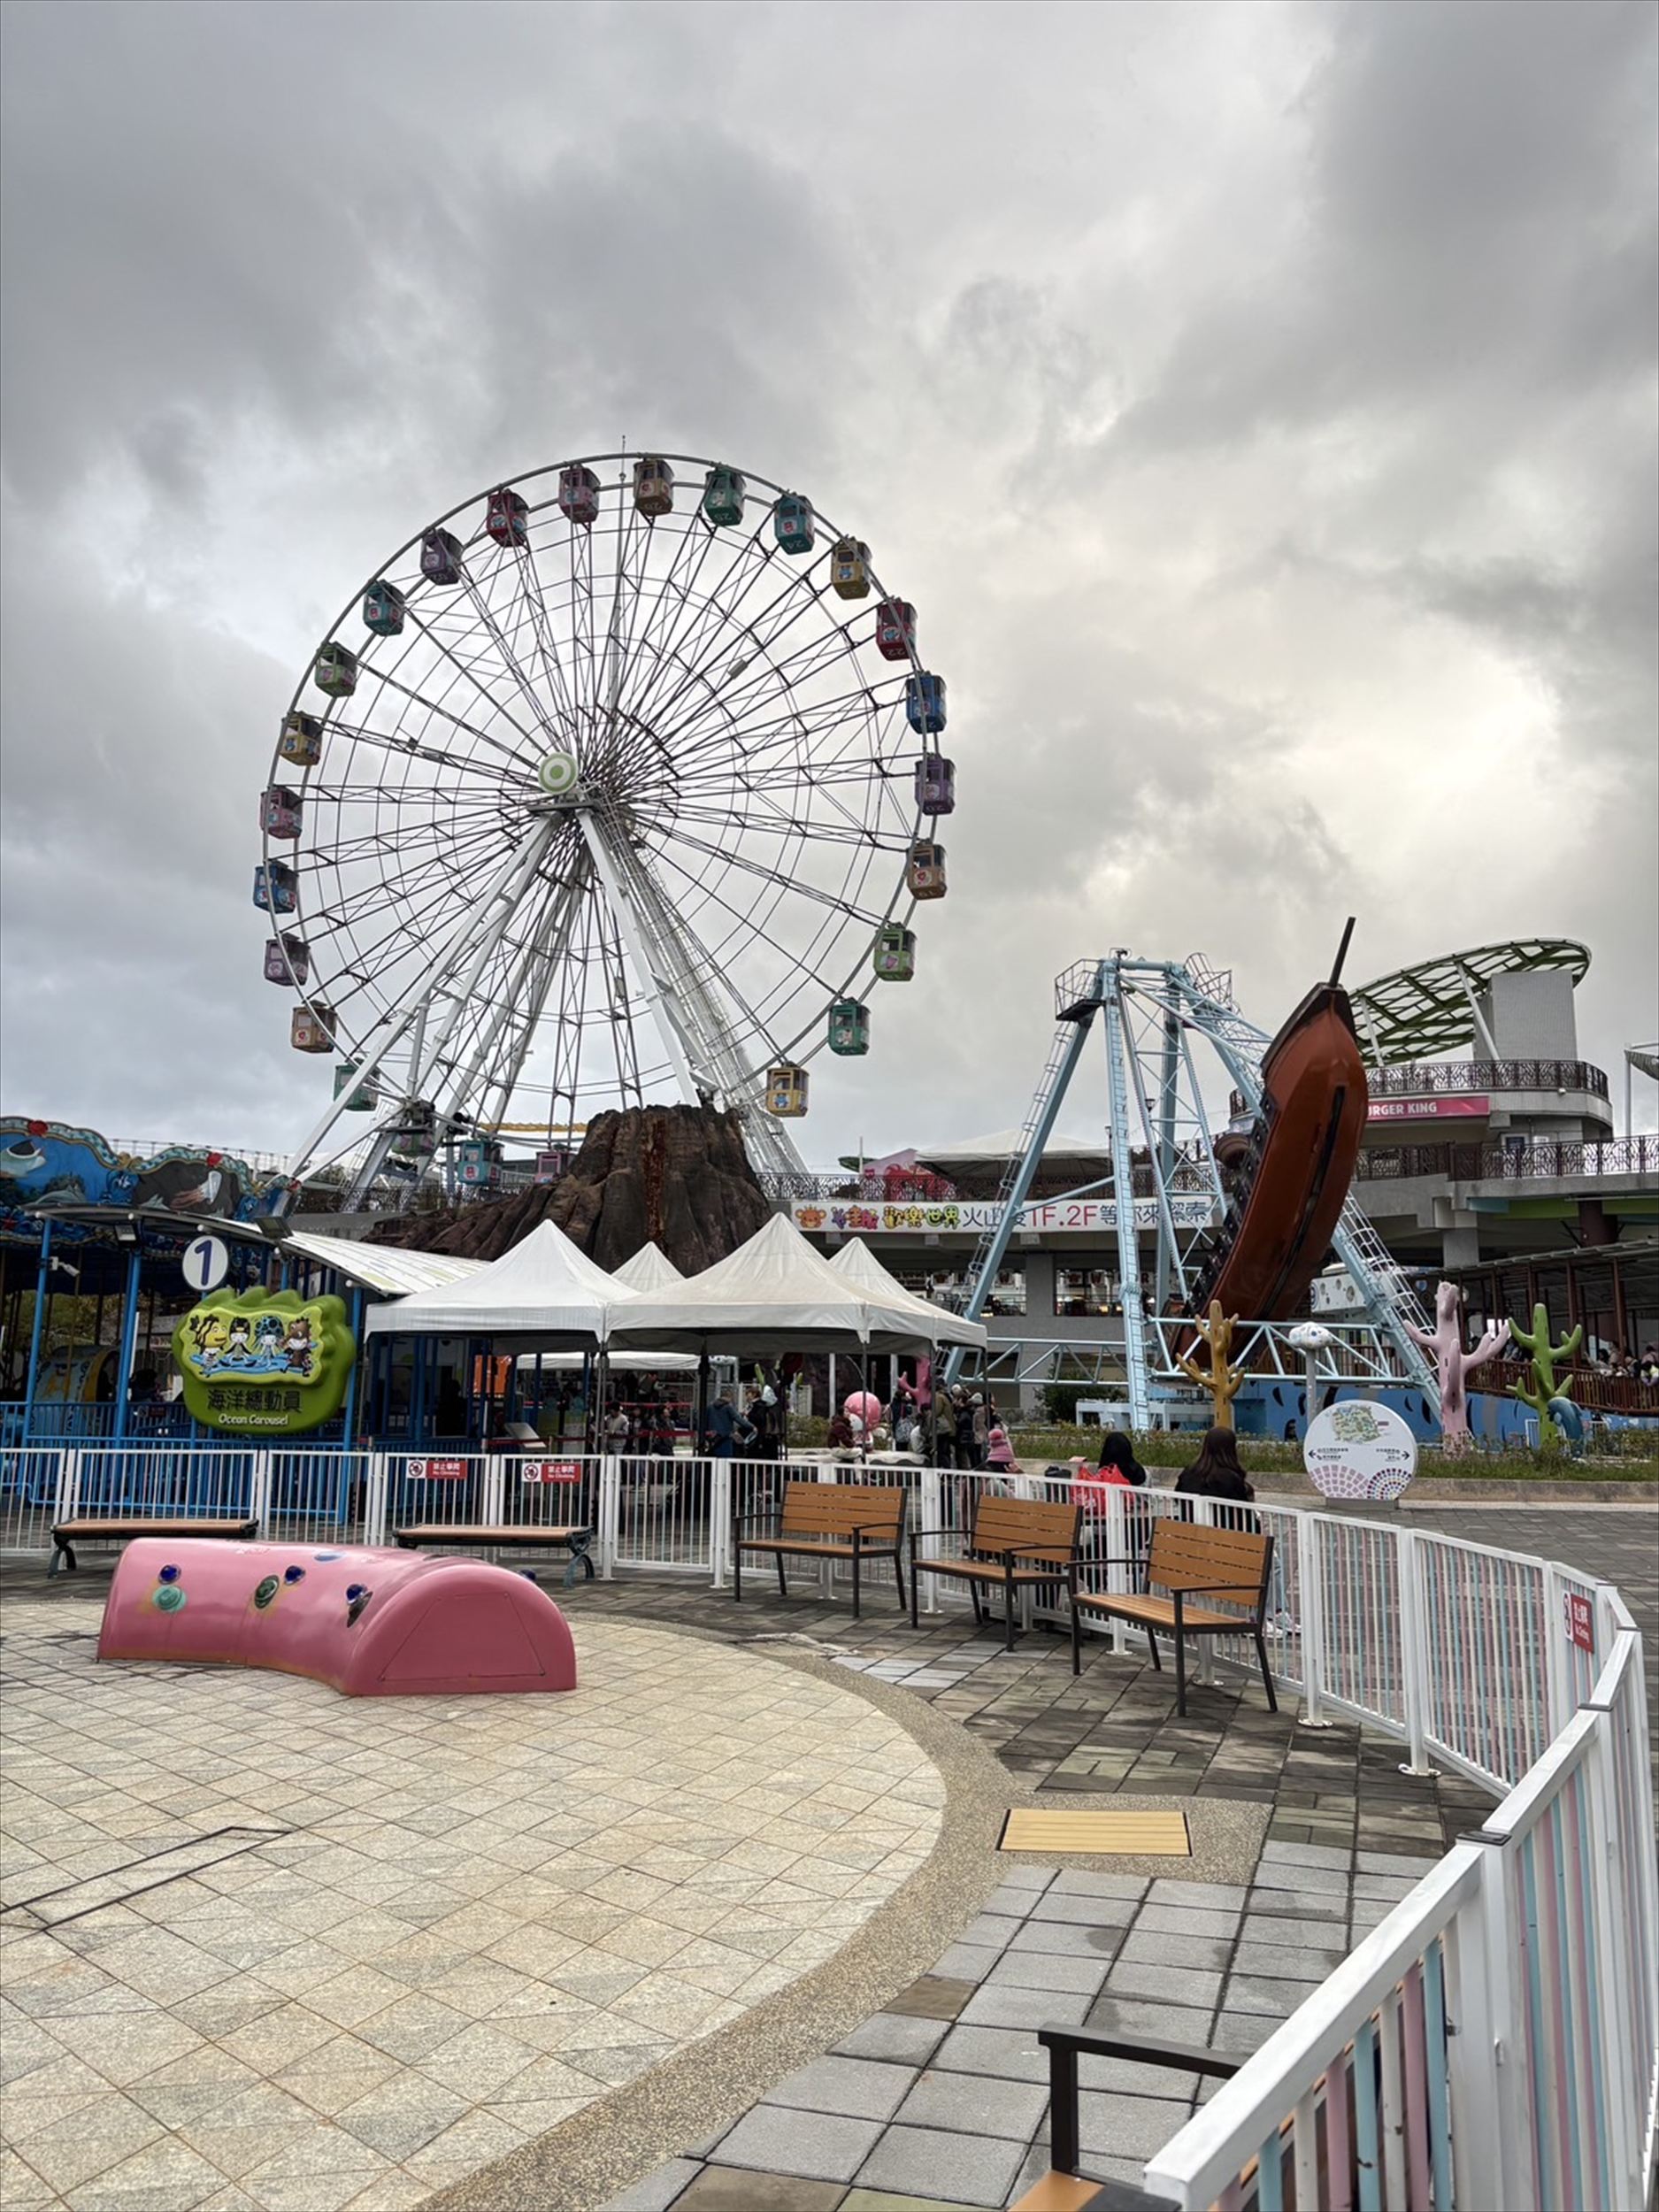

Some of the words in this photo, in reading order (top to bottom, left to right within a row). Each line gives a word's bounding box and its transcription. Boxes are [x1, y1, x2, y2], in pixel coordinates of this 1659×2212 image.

[886, 648, 905, 657] 22
[1407, 1102, 1438, 1114] KING
[194, 1240, 212, 1286] 1
[208, 1388, 302, 1413] 海洋總動員
[218, 1413, 248, 1425] Ocean
[249, 1413, 288, 1425] Carousel
